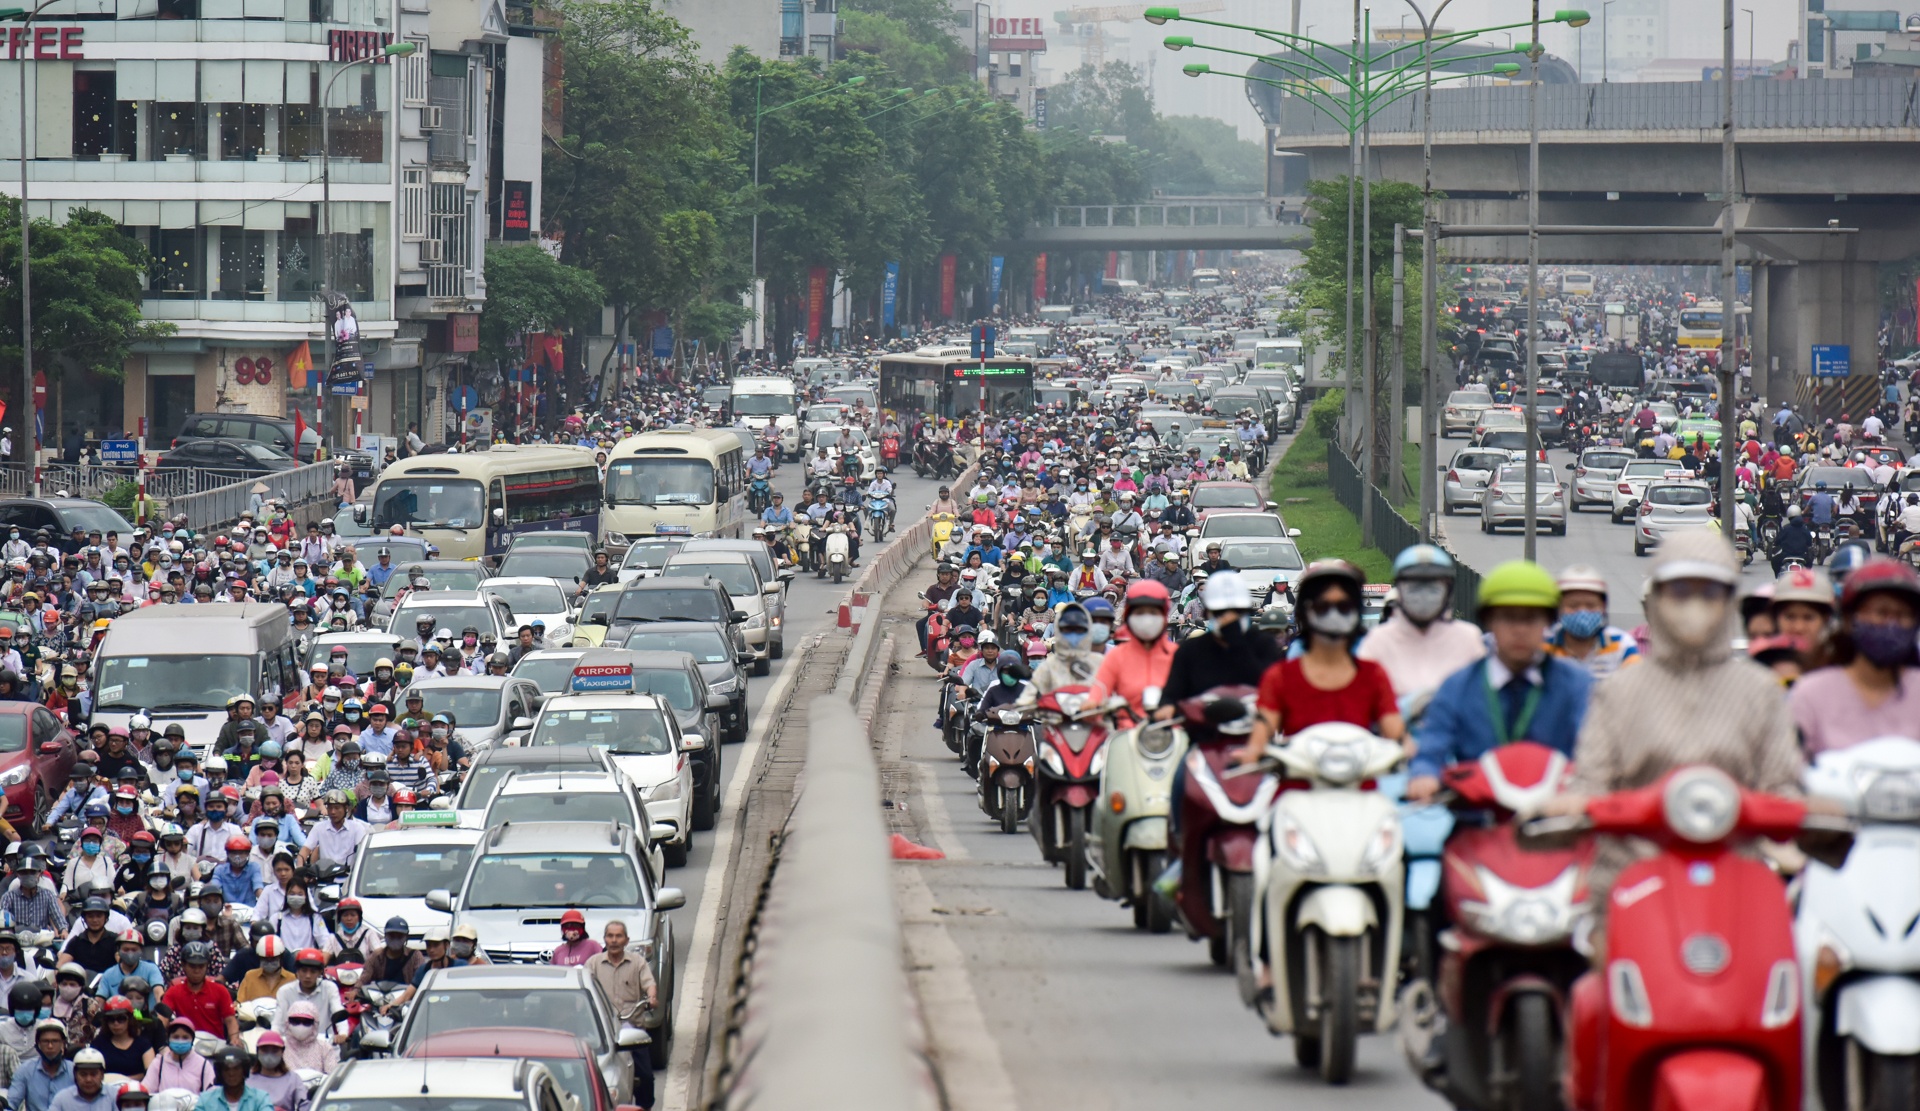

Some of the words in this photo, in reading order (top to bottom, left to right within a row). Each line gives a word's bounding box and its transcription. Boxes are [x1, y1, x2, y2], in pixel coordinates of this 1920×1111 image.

[328, 30, 394, 63] FIREFLY
[1037, 99, 1045, 127] HOTEL
[235, 356, 271, 385] 93
[578, 667, 628, 675] AIRPORT
[564, 954, 581, 964] BUY
